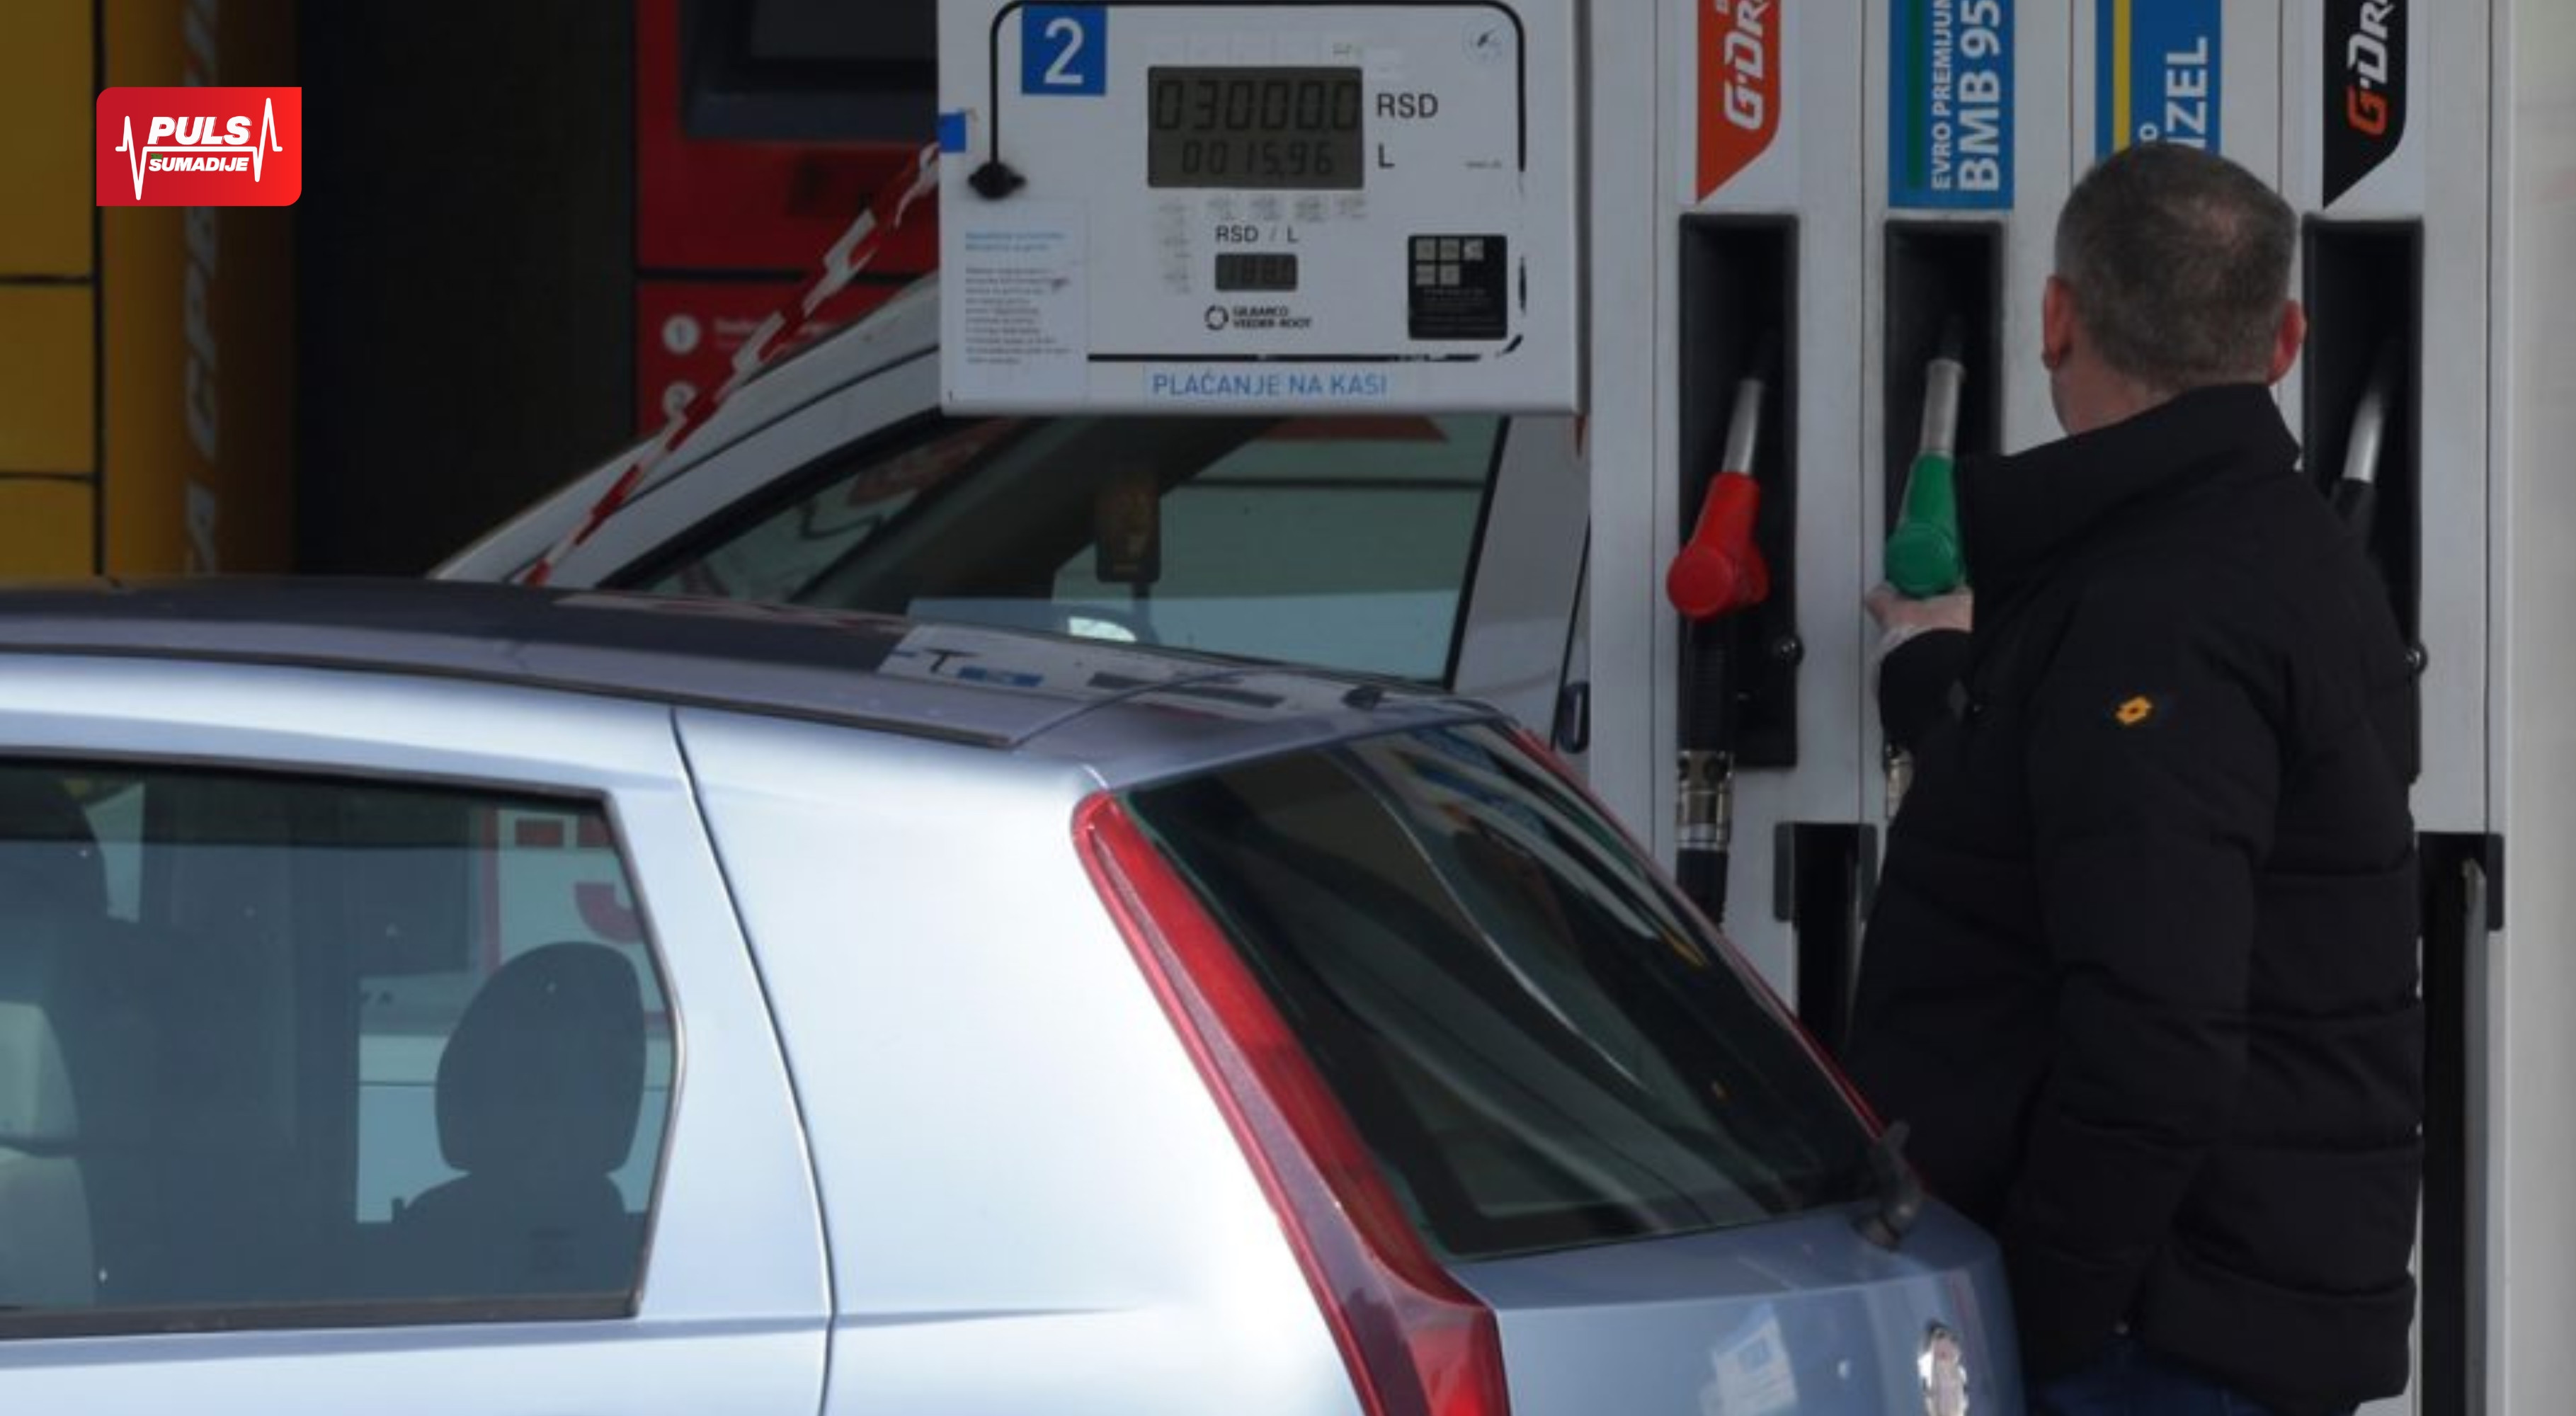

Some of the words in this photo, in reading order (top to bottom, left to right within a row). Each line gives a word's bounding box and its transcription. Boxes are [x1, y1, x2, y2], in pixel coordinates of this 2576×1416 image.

[1044, 17, 1083, 84] 2
[1960, 0, 2001, 59] 95
[1377, 93, 1438, 118] RSD
[2165, 36, 2208, 149] IZEL
[1378, 144, 1395, 169] L
[1930, 121, 1951, 190] EVRO
[1958, 69, 2001, 191] BMB
[1215, 226, 1258, 243] RSD
[1287, 226, 1299, 243] L
[1289, 373, 1323, 395] NA
[1330, 373, 1388, 395] KASI
